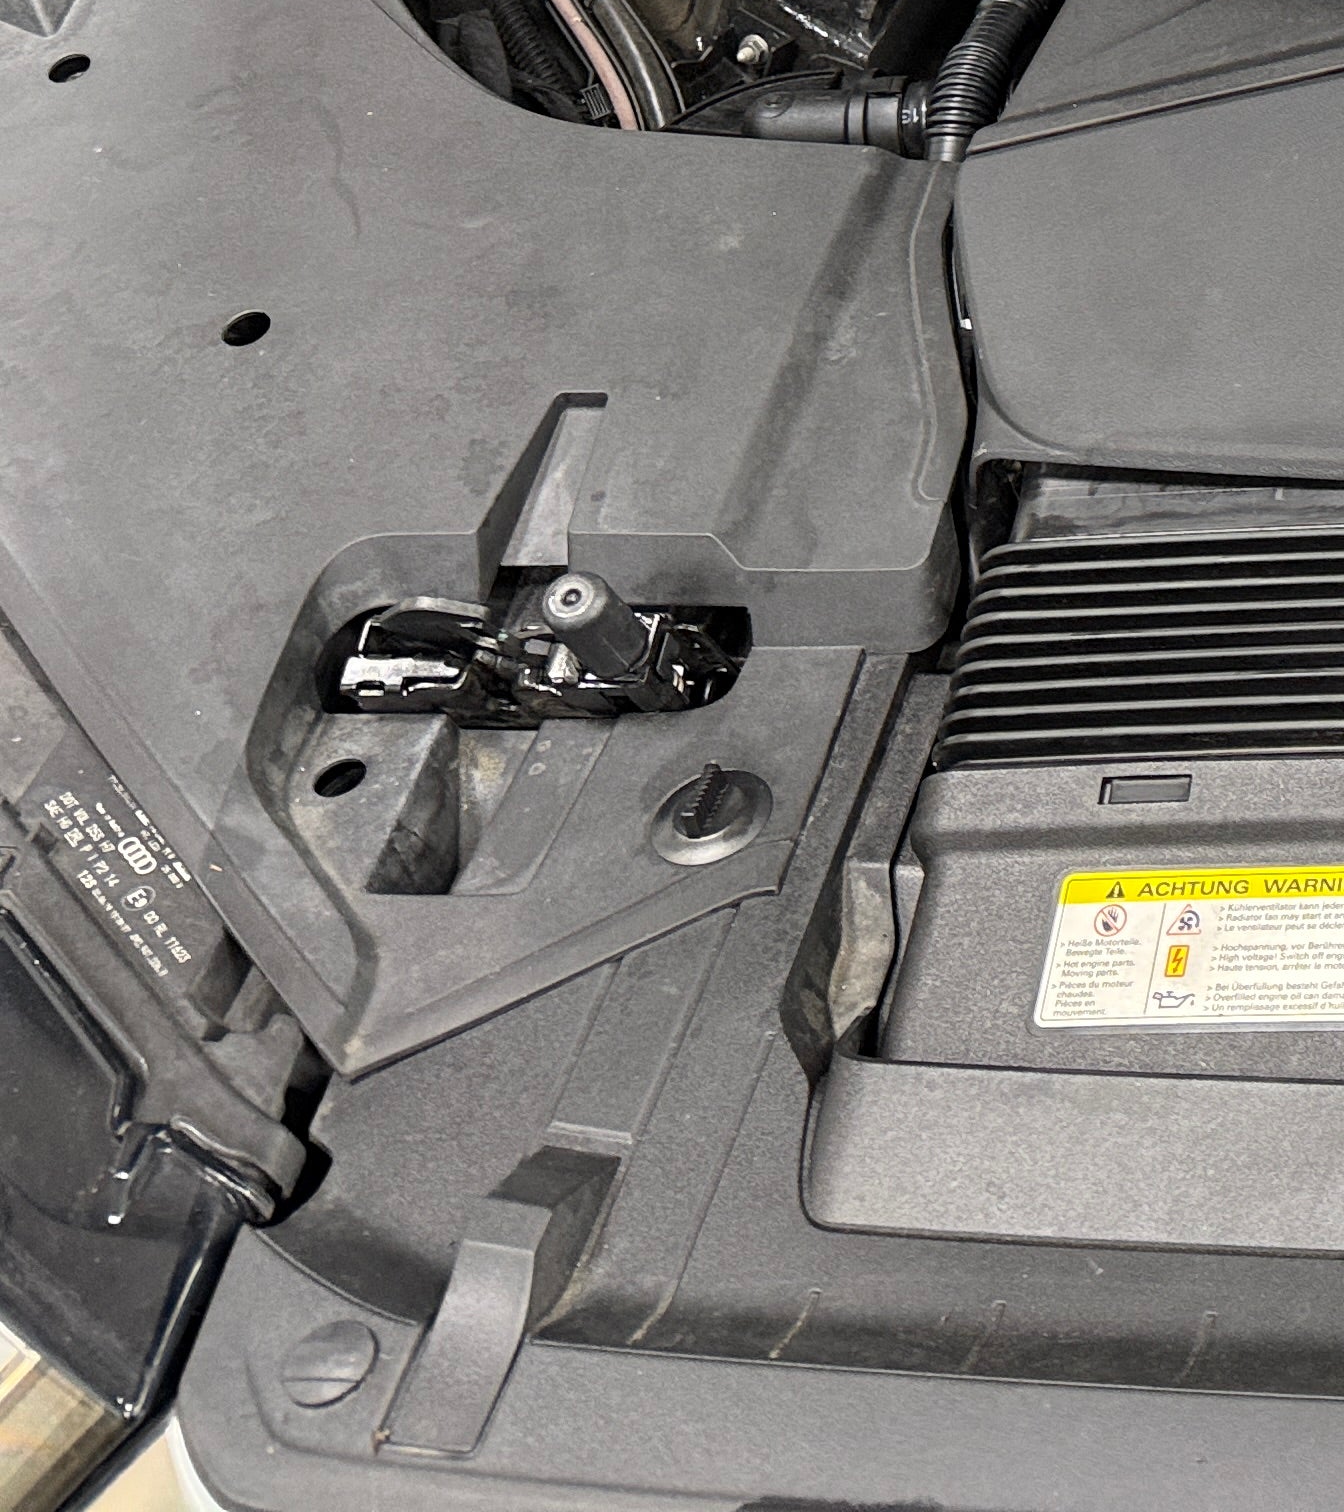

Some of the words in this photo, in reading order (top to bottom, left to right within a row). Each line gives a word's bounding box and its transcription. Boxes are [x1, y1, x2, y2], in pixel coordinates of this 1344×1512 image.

[58, 791, 79, 808] DOT
[44, 799, 64, 817] SAE
[1138, 880, 1249, 897] ACHTUNG
[126, 888, 147, 907] E9
[1299, 902, 1319, 910] kann
[1226, 913, 1263, 921] Radiator
[1264, 913, 1279, 921] fan
[1280, 913, 1300, 921] may
[1302, 912, 1321, 920] start
[1224, 924, 1235, 932] Le
[1237, 923, 1282, 931] ventilateur
[1285, 923, 1305, 932] peut
[1065, 949, 1102, 957] Bewegte
[1219, 953, 1240, 963] High
[1242, 953, 1278, 962] voltage!
[1280, 952, 1309, 961] Switch
[1311, 952, 1324, 960] off
[1080, 960, 1110, 969] engine
[1112, 959, 1135, 967] parts.
[1217, 964, 1243, 972] Haute
[1314, 962, 1321, 970] le
[1061, 969, 1094, 978] Moving
[1102, 980, 1134, 988] moteur
[1215, 983, 1229, 991] Bei
[1286, 981, 1318, 990] besteht
[1213, 993, 1256, 1001] Overfilled
[1258, 993, 1288, 1002] engine
[1290, 992, 1301, 1000] oil
[1211, 1004, 1224, 1012] Un
[1227, 1003, 1280, 1012] remplissage
[1282, 1002, 1318, 1010] excessif
